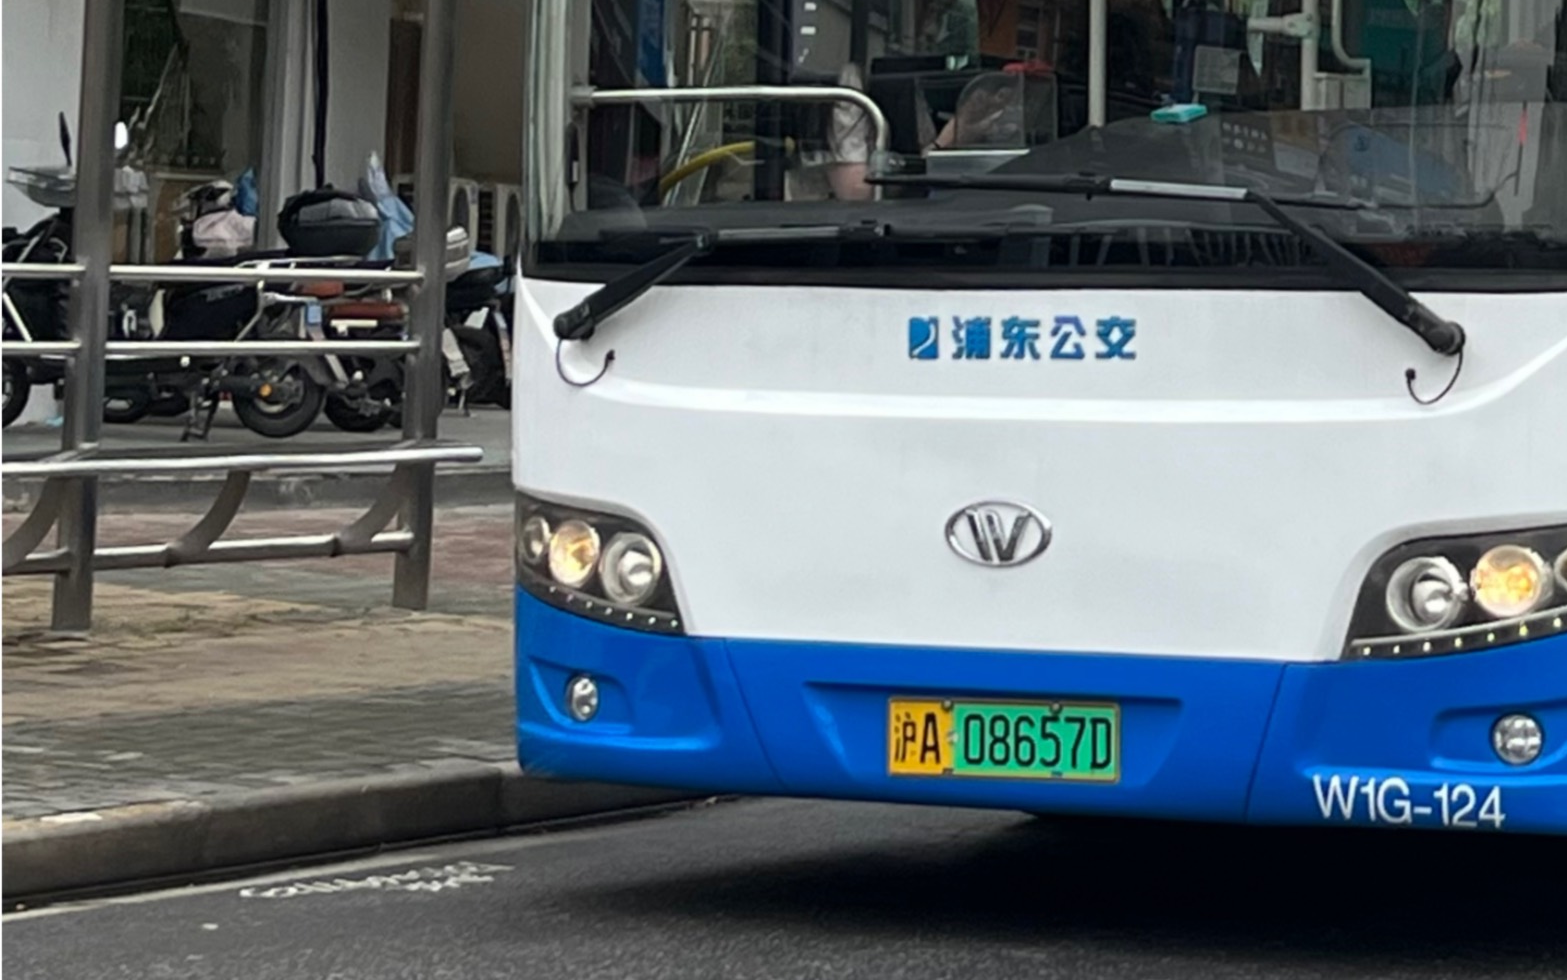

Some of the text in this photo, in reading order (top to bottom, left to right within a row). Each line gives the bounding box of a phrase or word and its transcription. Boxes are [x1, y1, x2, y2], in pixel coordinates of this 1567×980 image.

[951, 316, 1137, 360] 浦东公交
[1311, 773, 1507, 829] W1G-124
